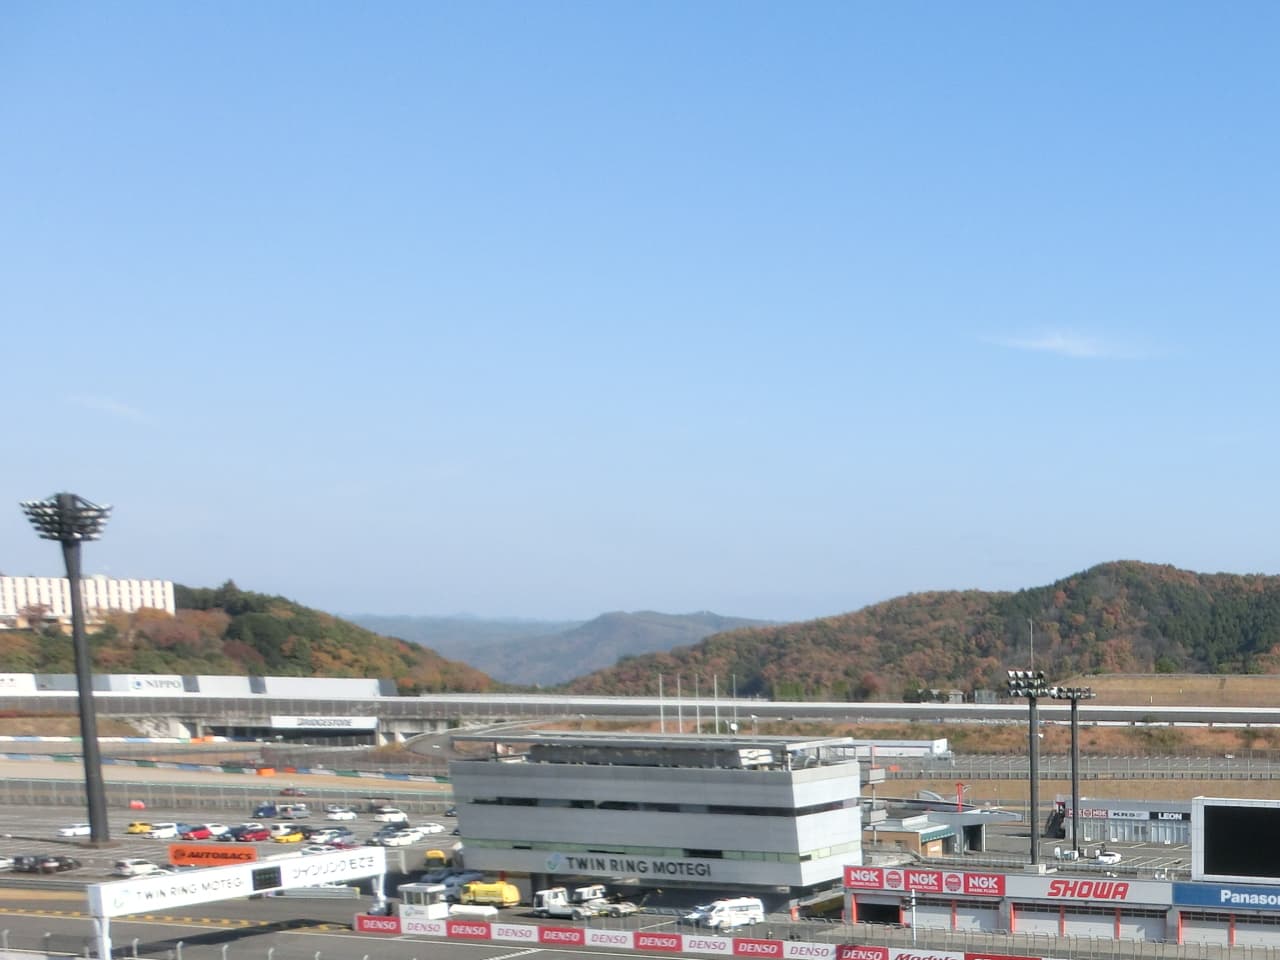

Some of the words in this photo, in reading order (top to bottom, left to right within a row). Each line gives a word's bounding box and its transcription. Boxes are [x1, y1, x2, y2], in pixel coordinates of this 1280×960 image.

[1158, 812, 1183, 820] LEON
[185, 849, 253, 861] AUTOBACS
[565, 857, 606, 871] TWIN
[610, 859, 648, 873] RING
[652, 862, 711, 876] MOTEGI
[850, 870, 879, 882] NGK
[909, 872, 938, 885] NGK
[968, 876, 998, 889] NGK
[171, 883, 198, 895] RING
[1047, 880, 1130, 900] SHOWA
[364, 920, 397, 930] DENSO
[407, 922, 441, 933] DENSO
[451, 924, 487, 935] DENSO
[496, 927, 532, 938] DENSO
[544, 930, 580, 941] DENSO
[591, 933, 628, 944] DENSO
[639, 936, 678, 947] DENSO
[688, 939, 727, 951] DENSO
[738, 943, 777, 954] DENSO
[790, 946, 829, 957] DENSO
[842, 950, 883, 960] DENSO
